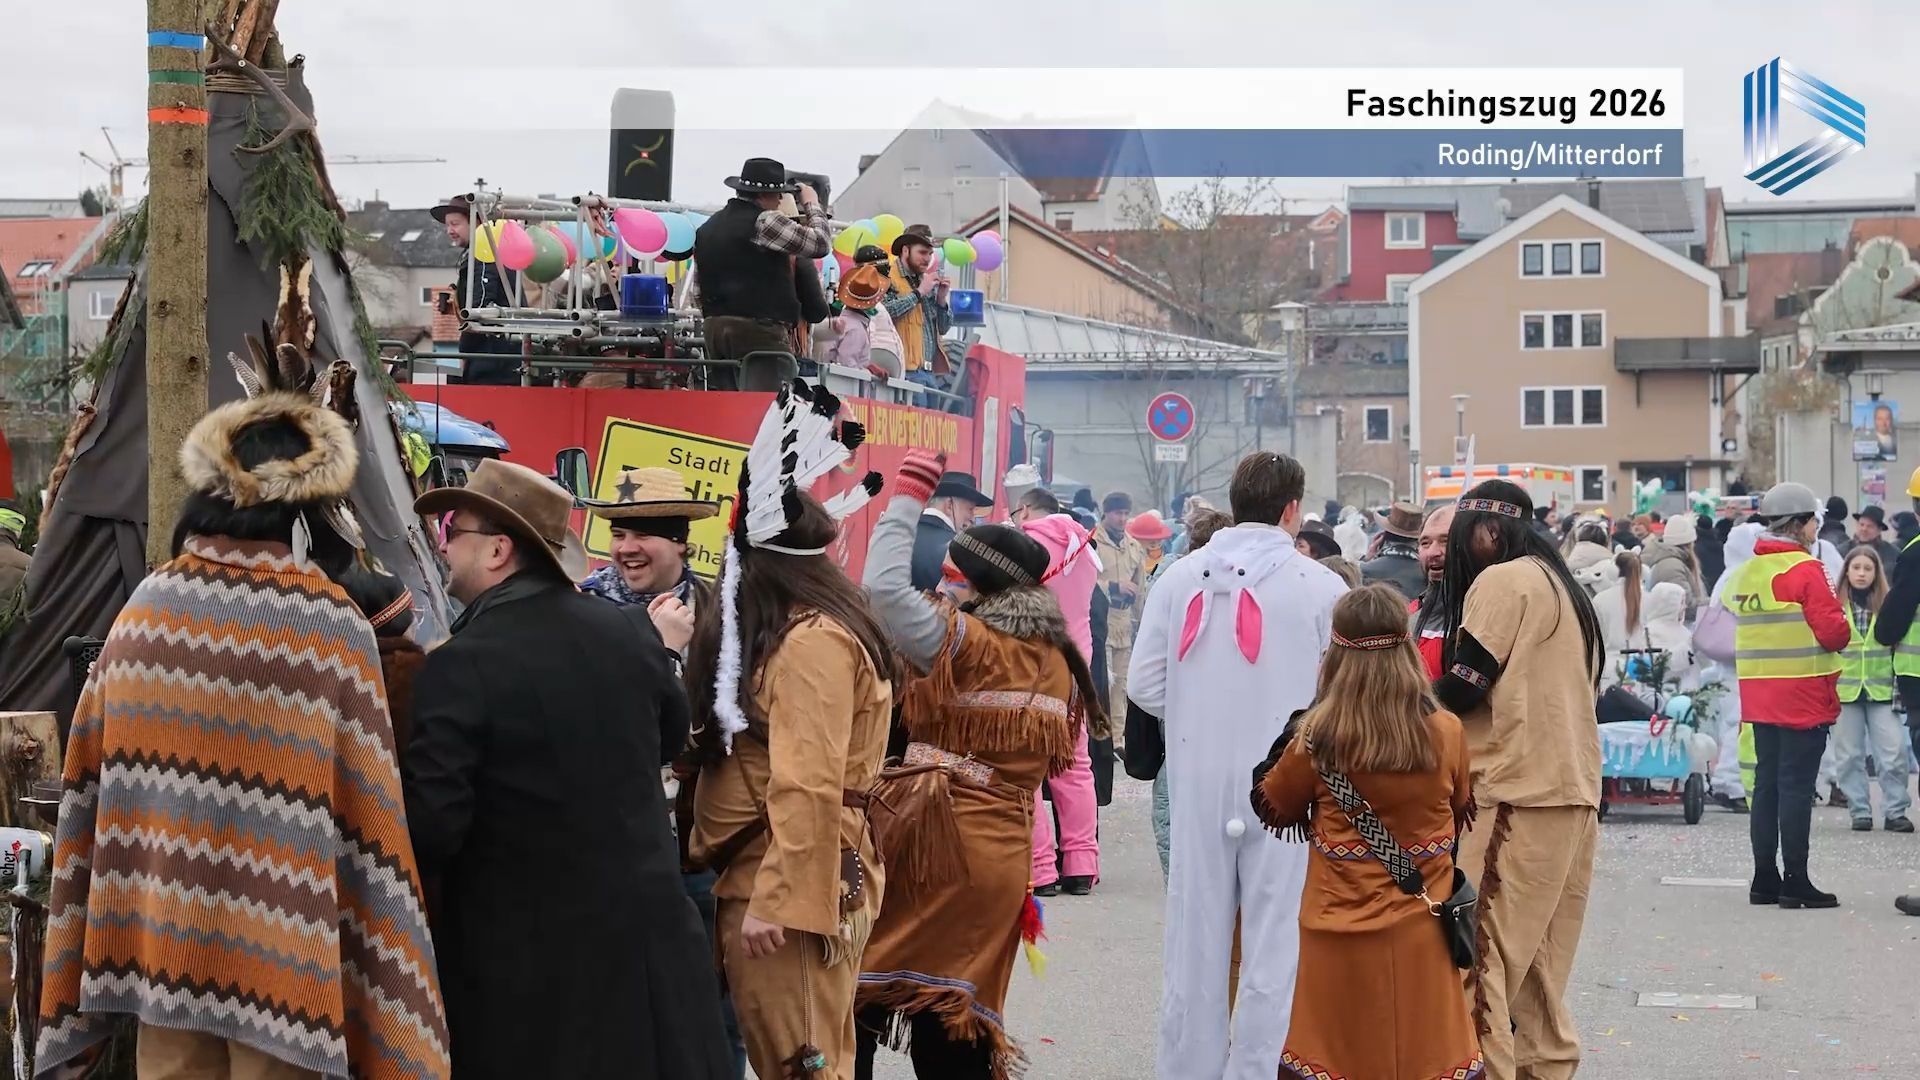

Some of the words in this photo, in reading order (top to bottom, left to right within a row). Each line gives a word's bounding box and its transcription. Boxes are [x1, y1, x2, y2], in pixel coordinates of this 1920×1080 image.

[889, 408, 922, 448] WESTEN
[923, 412, 936, 450] ON
[937, 416, 958, 454] TOUR
[668, 447, 731, 475] Stadt
